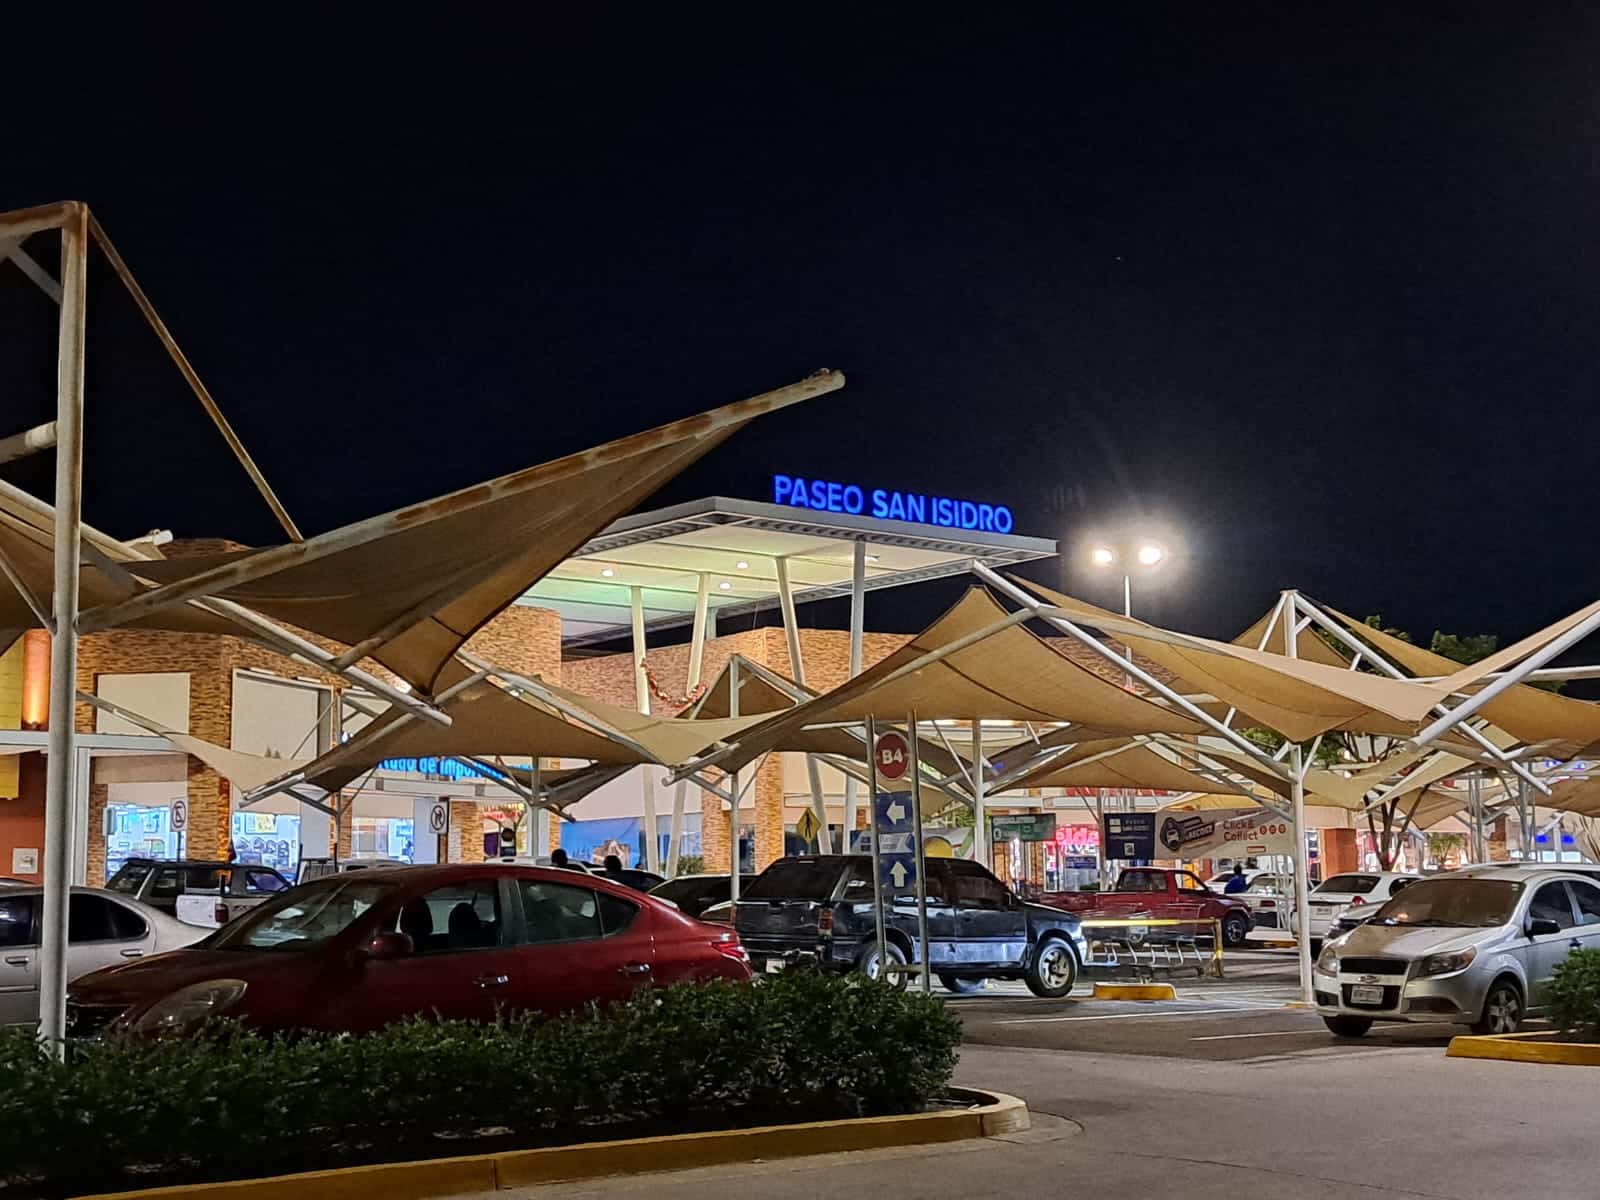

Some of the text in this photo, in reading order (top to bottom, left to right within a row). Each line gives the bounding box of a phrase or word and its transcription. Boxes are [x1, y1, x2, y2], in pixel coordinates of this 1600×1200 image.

[774, 475, 1013, 533] PASEO SAN ISIDRO
[881, 749, 904, 765] B4
